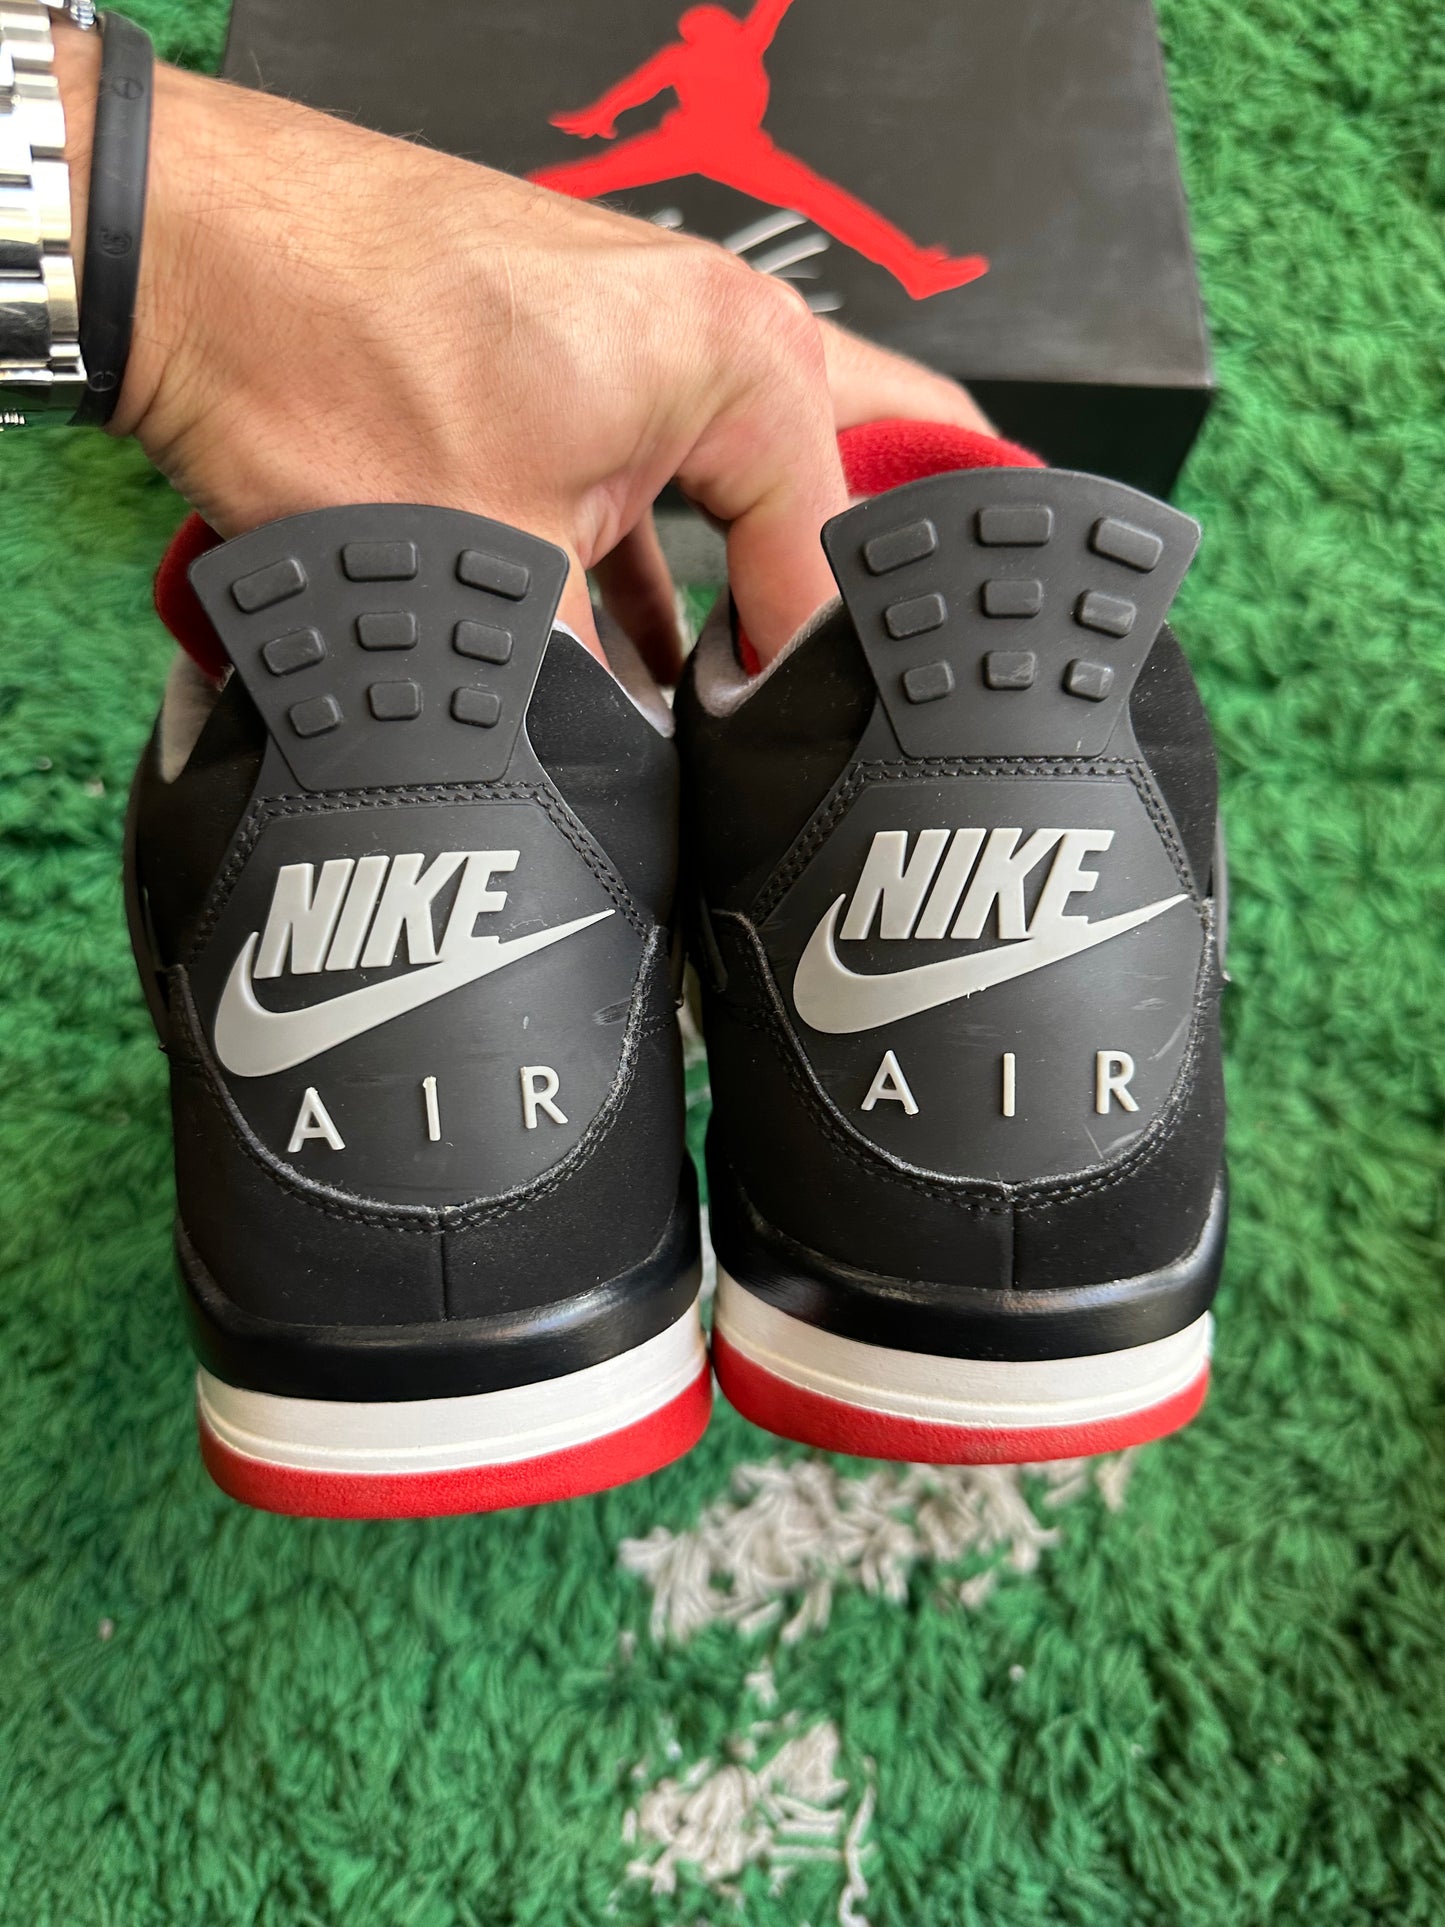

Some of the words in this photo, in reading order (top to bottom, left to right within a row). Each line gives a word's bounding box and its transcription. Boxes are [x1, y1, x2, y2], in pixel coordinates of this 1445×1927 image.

[253, 850, 520, 979] NIKE
[840, 827, 1116, 940] NIKE
[287, 1064, 568, 1153] AIR
[861, 1050, 1140, 1117] AIR
